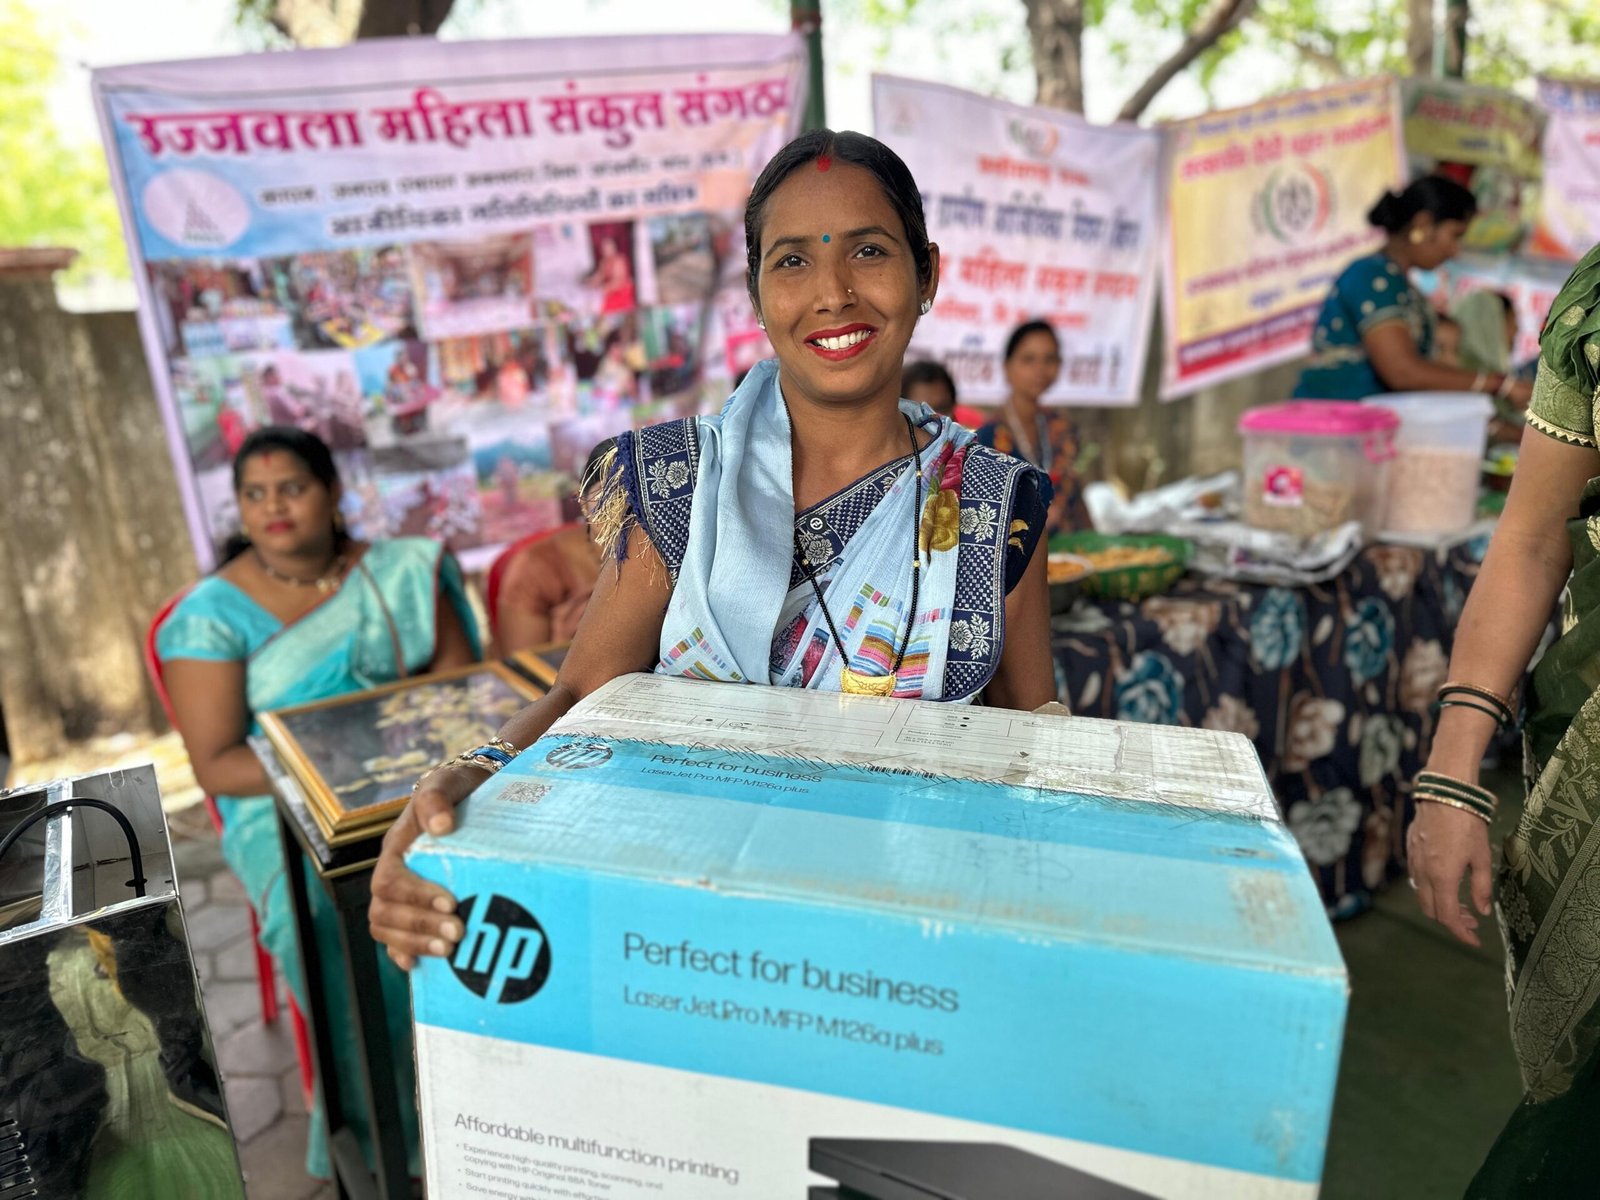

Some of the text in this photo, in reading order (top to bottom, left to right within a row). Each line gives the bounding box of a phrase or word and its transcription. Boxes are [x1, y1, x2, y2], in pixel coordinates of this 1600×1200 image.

[124, 109, 362, 156] उज्जवला
[370, 87, 532, 148] महिला
[541, 79, 665, 146] संकुल
[650, 754, 823, 783] Perfect for business
[783, 785, 810, 795] plus
[453, 893, 545, 1004] hp
[624, 932, 960, 1013] Perfect for business
[763, 1006, 814, 1031] MFP
[894, 1031, 944, 1056] plus
[454, 1112, 740, 1185] Affordable multifunction printing
[463, 1143, 511, 1160] Experience
[464, 1154, 497, 1169] copying
[498, 1162, 517, 1171] with
[465, 1168, 487, 1179] Start
[488, 1174, 521, 1188] printing
[553, 1187, 573, 1197] with
[466, 1182, 488, 1193] Save
